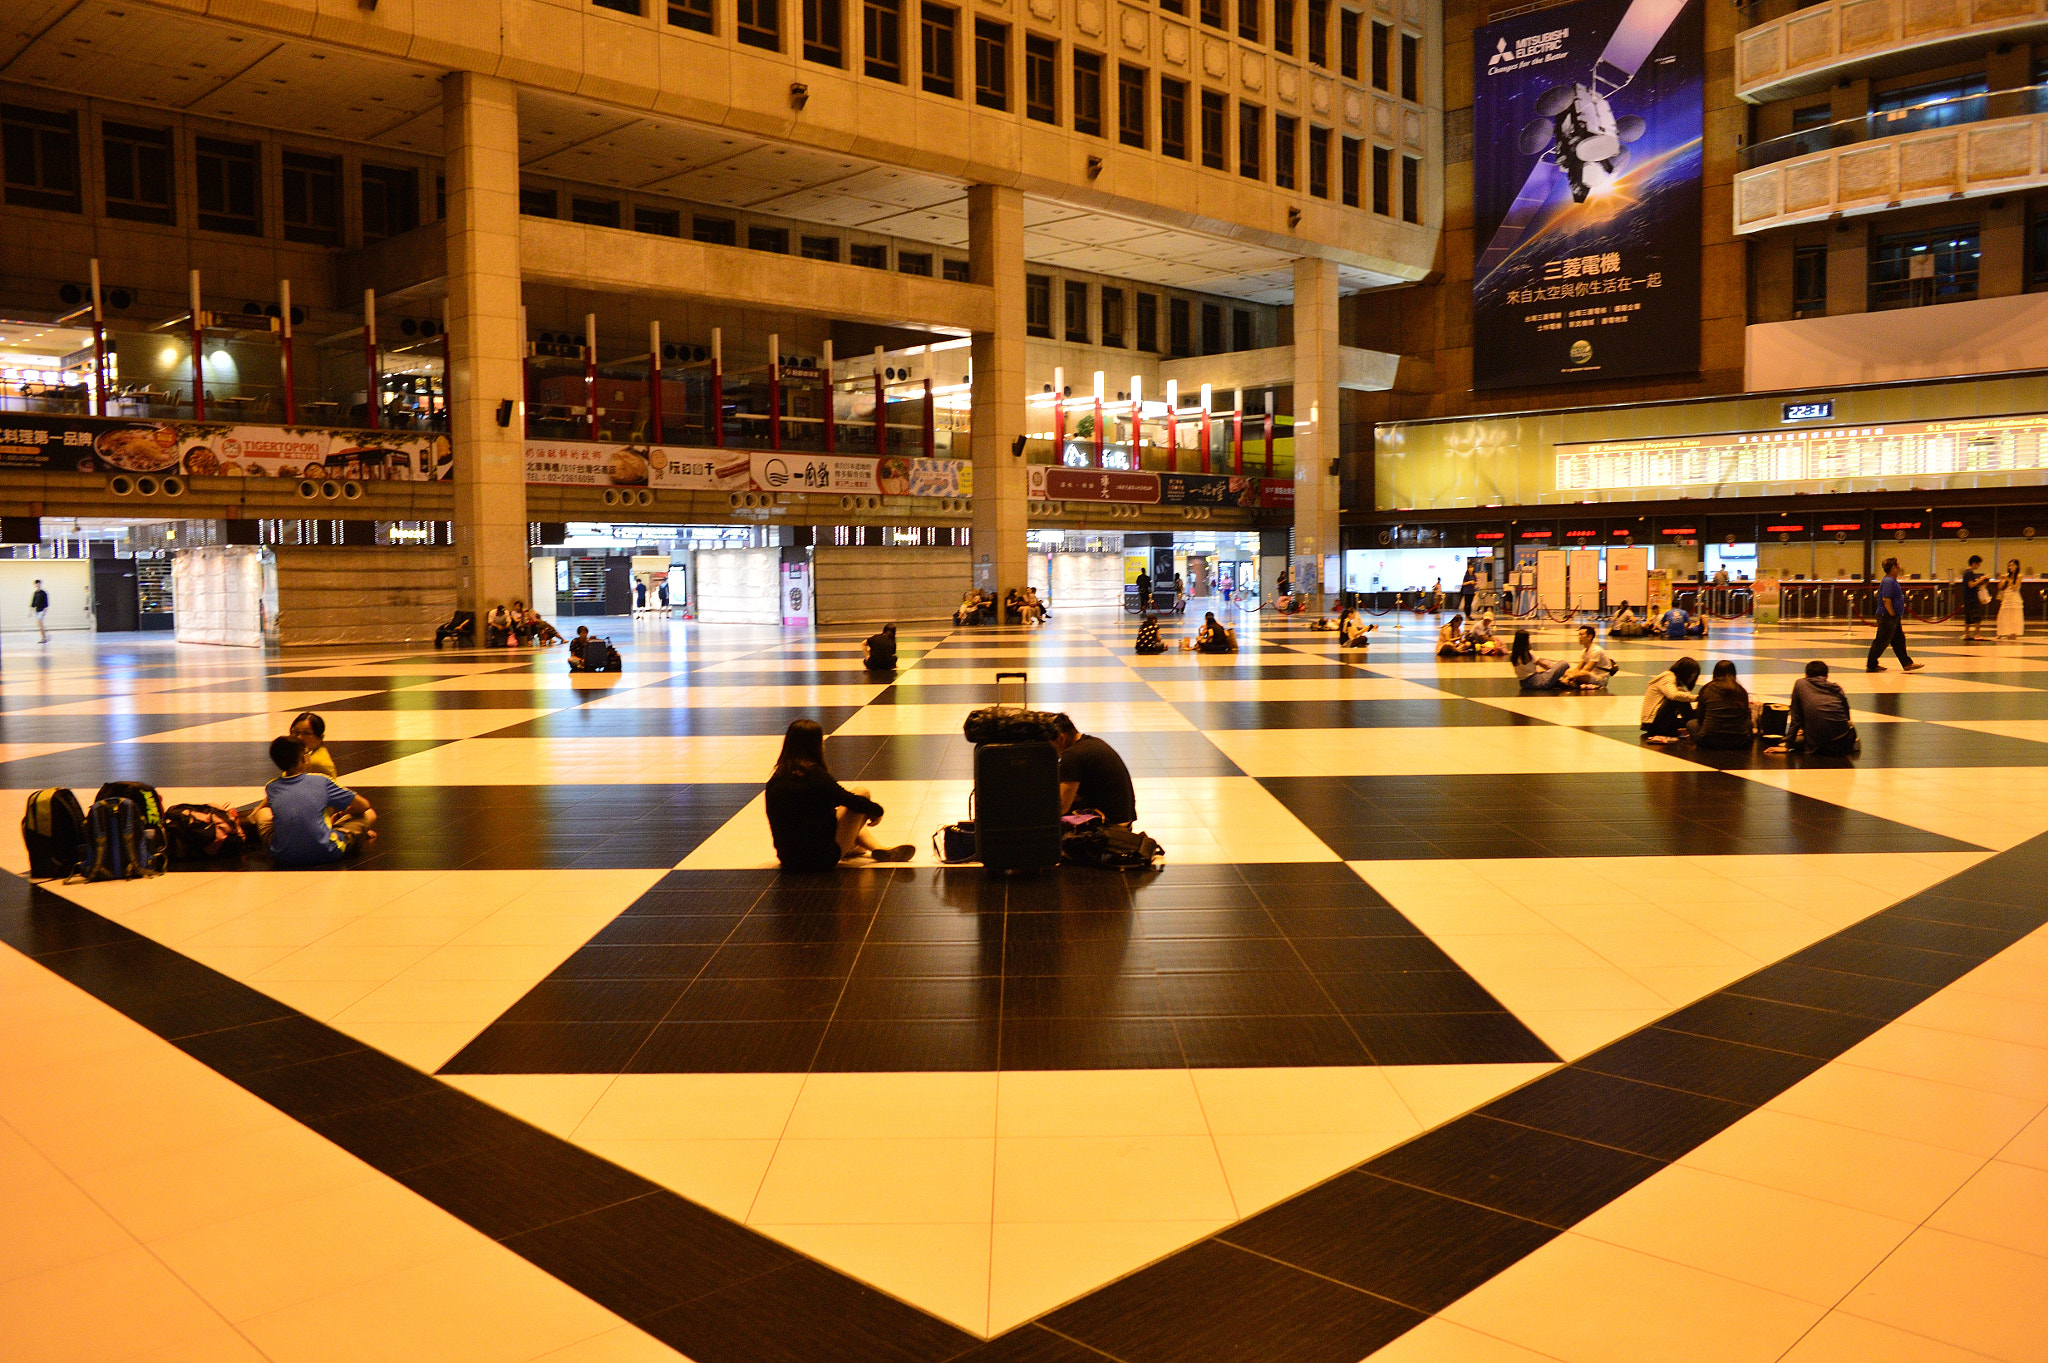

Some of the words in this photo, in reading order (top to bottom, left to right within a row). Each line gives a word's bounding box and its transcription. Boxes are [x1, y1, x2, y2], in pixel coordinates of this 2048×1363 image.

[1515, 27, 1570, 50] MITSUBISHI
[1515, 39, 1563, 59] ELECTRIC
[1487, 63, 1518, 76] Changes
[1518, 60, 1531, 69] for
[1531, 57, 1544, 66] the
[1544, 52, 1570, 63] Better
[1543, 251, 1621, 281] 三菱電機
[1506, 272, 1663, 305] 來自太空與你生活在一起
[1788, 404, 1829, 419] 22:31
[0, 428, 94, 448] 料理第一品牌
[243, 440, 320, 456] TIGERTOPOKI
[1683, 439, 1701, 447] Time
